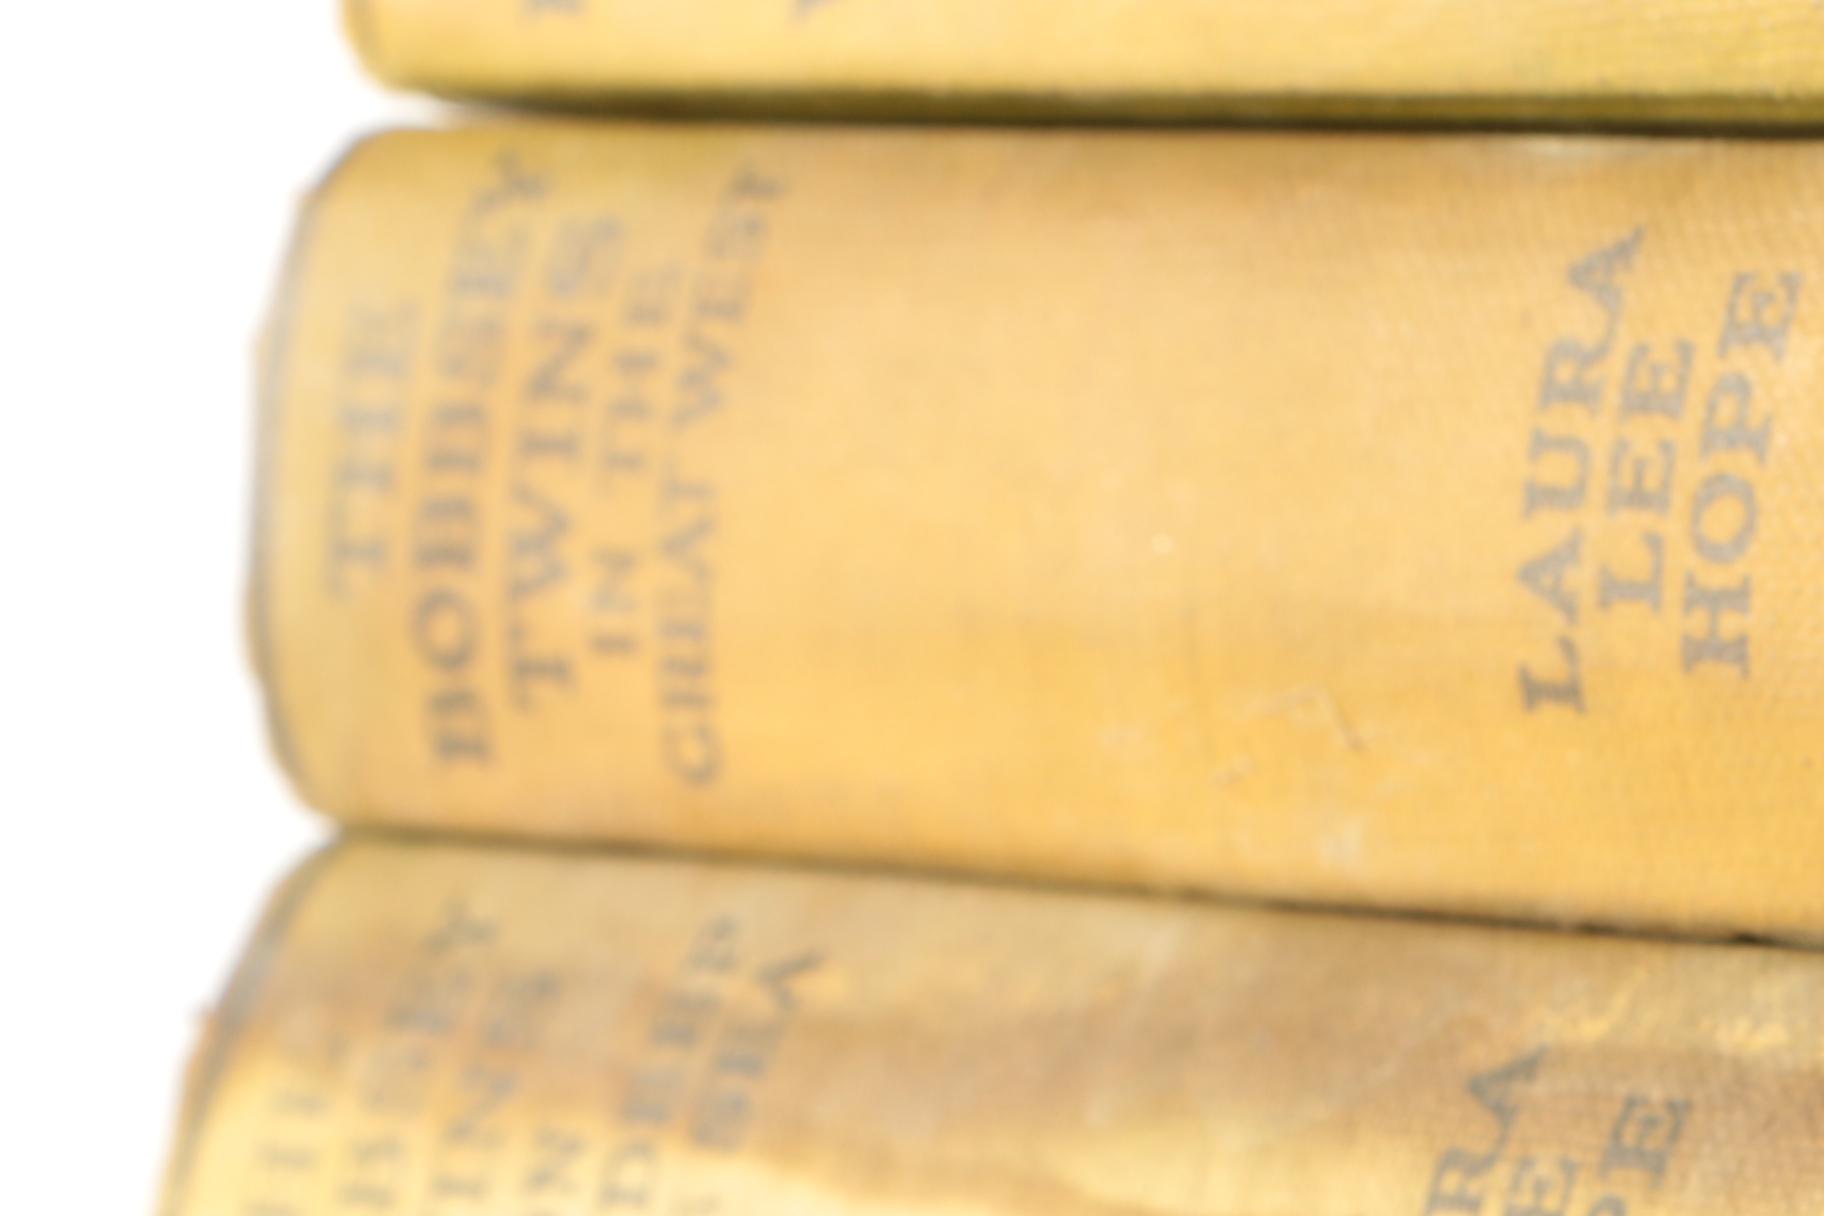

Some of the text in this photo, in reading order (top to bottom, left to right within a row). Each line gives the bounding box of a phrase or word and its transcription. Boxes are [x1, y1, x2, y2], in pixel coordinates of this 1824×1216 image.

[322, 299, 417, 599] THE
[503, 214, 625, 712] TWINS
[589, 263, 684, 661] IN THE
[657, 162, 788, 789] GREAT WEST
[1515, 222, 1646, 715] LAURA
[1597, 337, 1695, 615] LEE
[1681, 270, 1804, 682] HOPE
